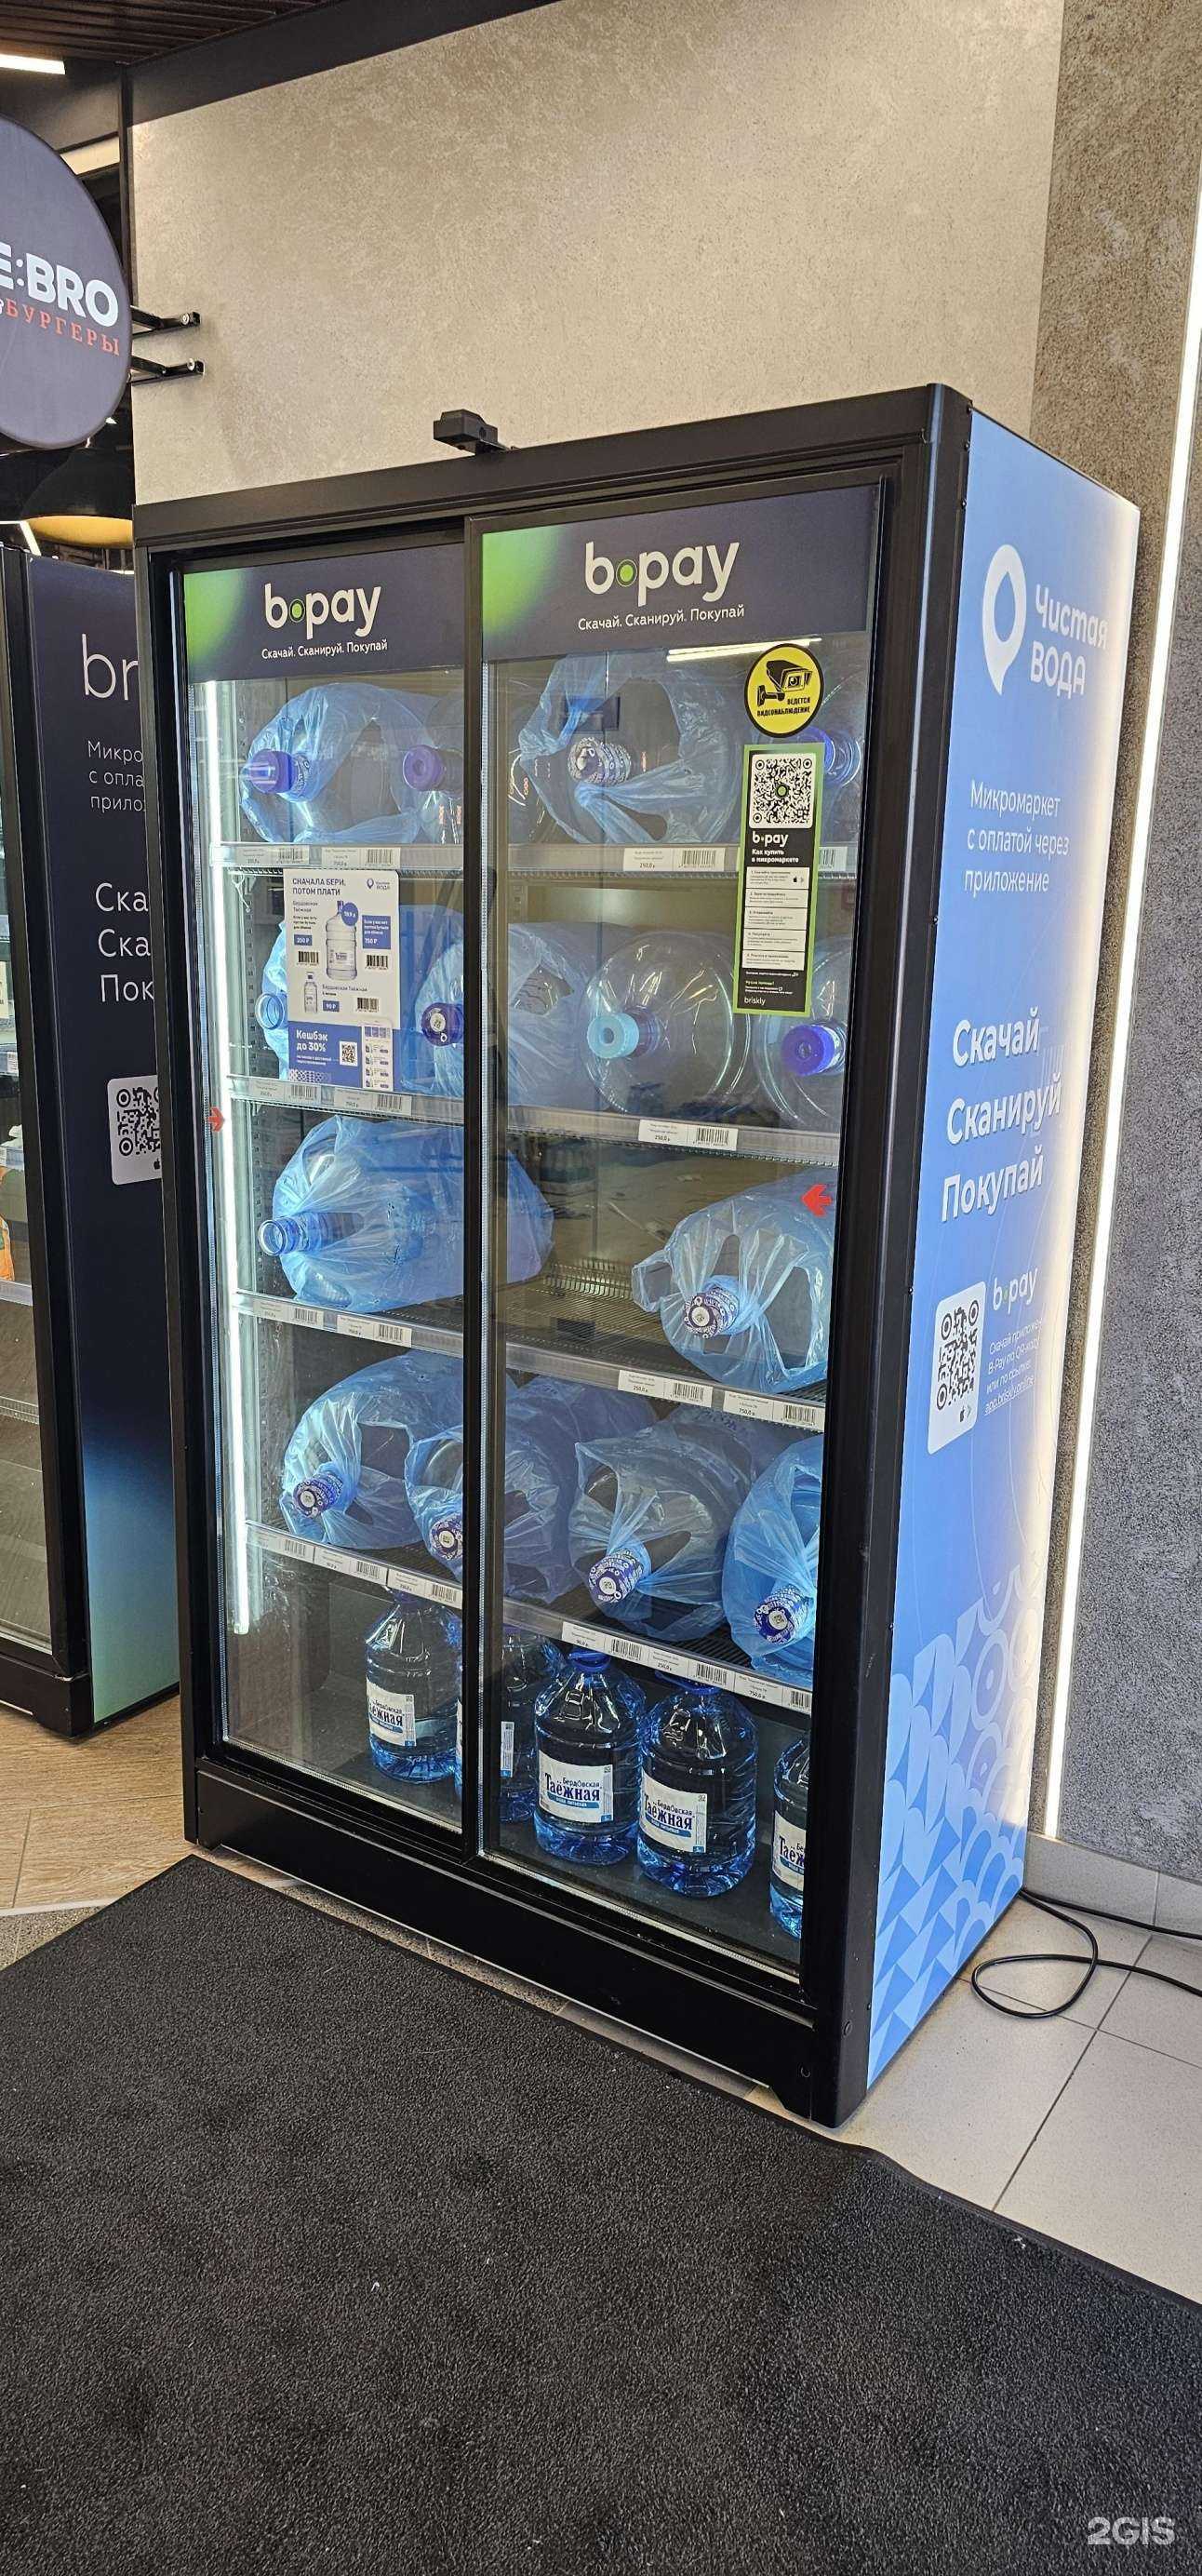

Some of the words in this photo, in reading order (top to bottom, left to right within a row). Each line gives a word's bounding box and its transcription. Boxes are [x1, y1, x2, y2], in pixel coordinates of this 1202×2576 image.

[6, 298, 120, 356] БУРГЕРЫ
[578, 615, 622, 631] Скачай.
[625, 610, 687, 627] Сканируй.
[690, 604, 744, 623] Покупай
[1035, 584, 1109, 651] Чистая
[261, 646, 296, 659] Скачай.
[298, 642, 344, 657] Сканируй.
[347, 638, 388, 653] Покупай
[1030, 640, 1087, 699] ВОДА
[87, 740, 142, 765] Микро
[88, 771, 98, 784] с
[104, 771, 144, 787] опла
[90, 796, 146, 812] прило
[970, 778, 1061, 820] Микромаркет
[967, 828, 975, 851] с
[979, 826, 1032, 853] оплатой
[1035, 833, 1070, 861] через
[292, 878, 325, 886] СНАЧАЛА
[292, 887, 316, 895] ПОТОМ
[964, 869, 1049, 898] приложение
[95, 882, 149, 912] Ска
[98, 929, 151, 958] Ска
[744, 997, 766, 1005] briskly
[296, 1029, 328, 1041] Кешбэк
[296, 1042, 307, 1052] до
[309, 1041, 327, 1053] 30%
[953, 1005, 1041, 1067] Скачай
[946, 1072, 1062, 1145] Сканируй
[941, 1145, 1045, 1222] Покупай
[545, 1773, 600, 1801] Таёжная
[645, 1793, 692, 1831] Таёжная
